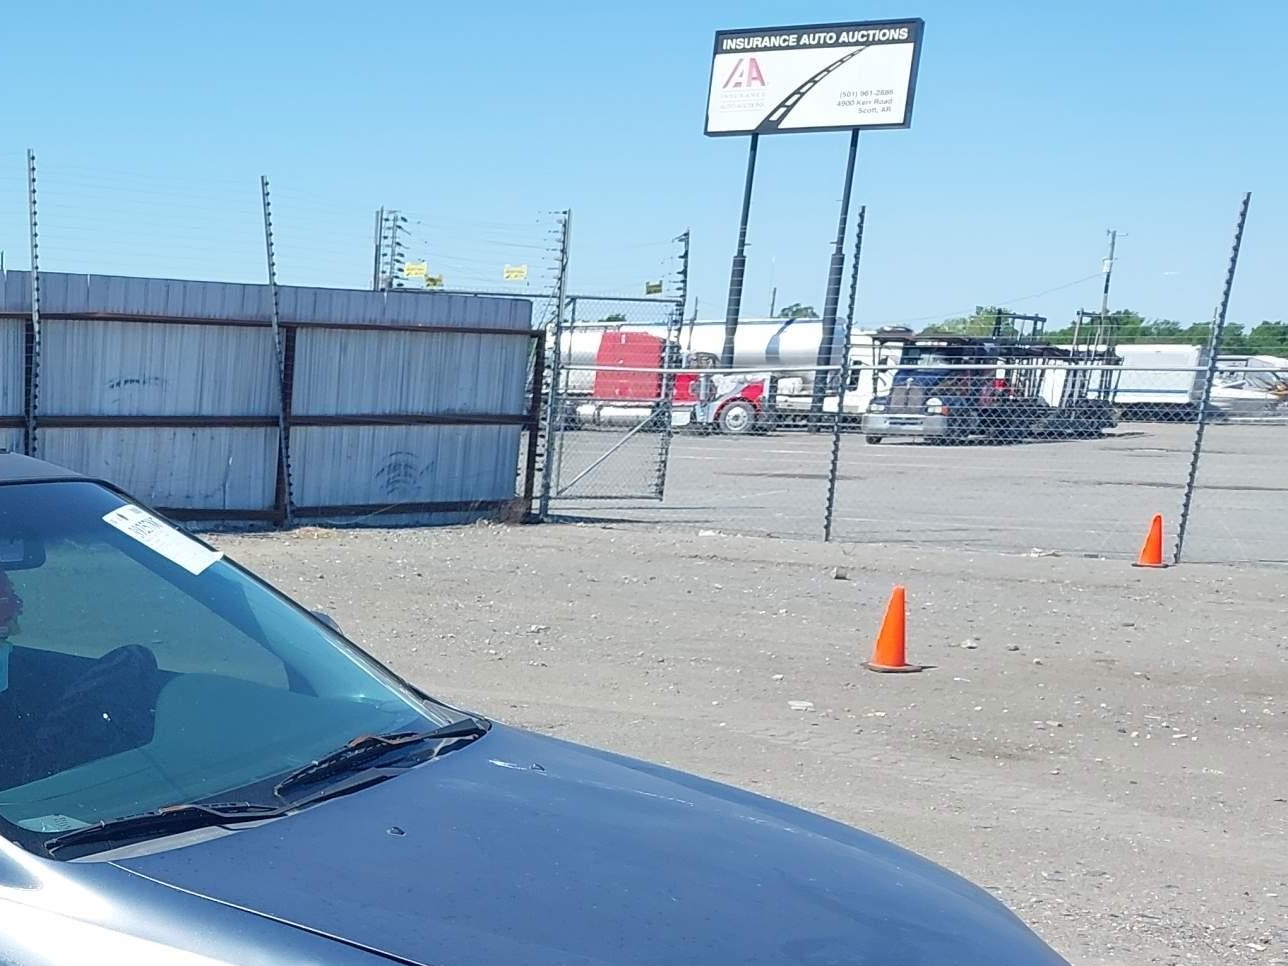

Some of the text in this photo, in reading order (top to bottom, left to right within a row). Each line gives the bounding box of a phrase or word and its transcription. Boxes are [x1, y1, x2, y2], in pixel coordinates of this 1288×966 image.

[723, 28, 908, 50] INSURANCE AUTO AUCTIONS
